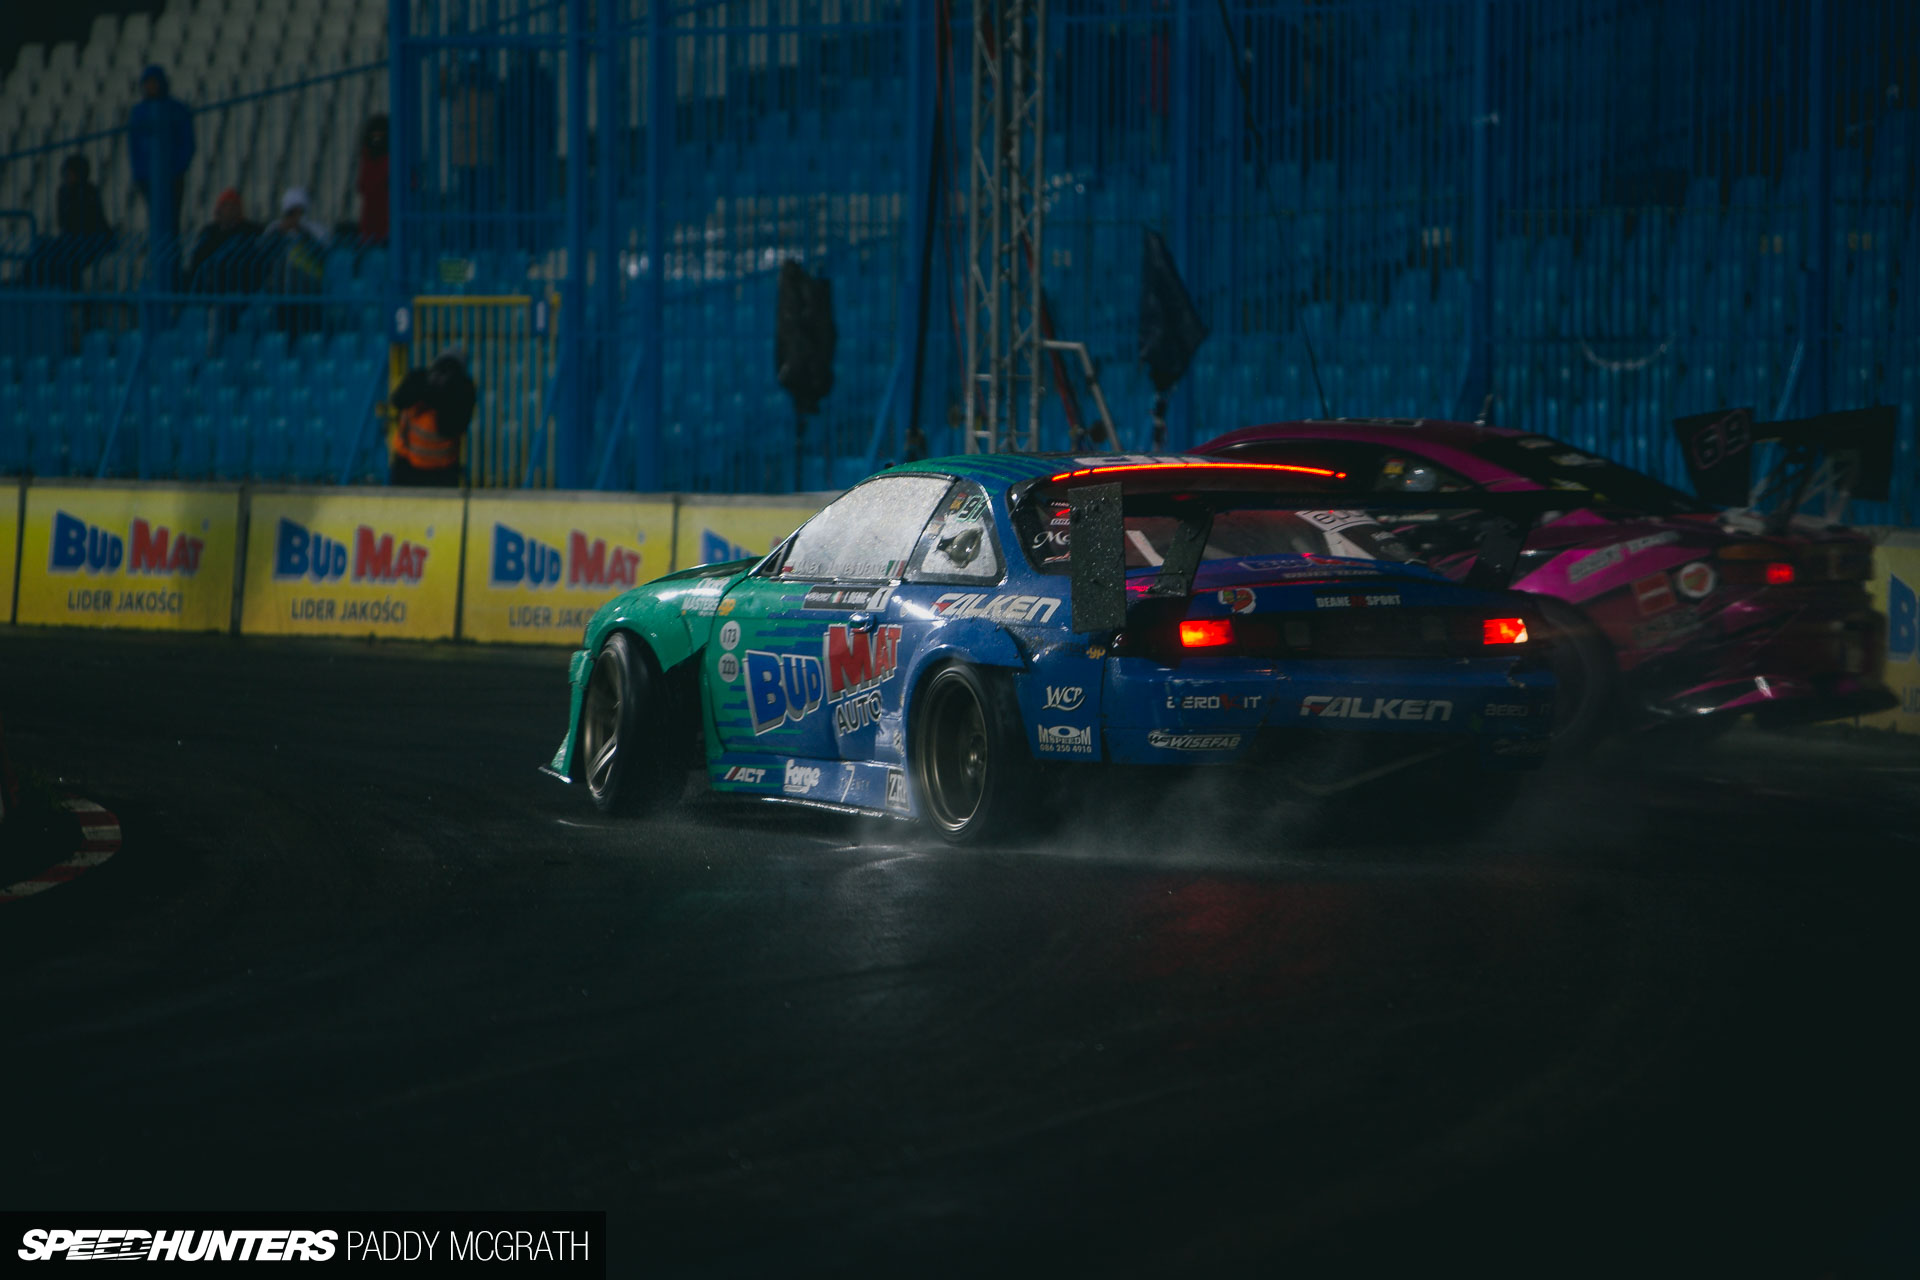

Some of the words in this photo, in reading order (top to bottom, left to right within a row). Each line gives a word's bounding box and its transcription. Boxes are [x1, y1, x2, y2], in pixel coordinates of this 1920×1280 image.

[51, 509, 123, 573] BUD
[128, 517, 205, 576] MAT
[275, 517, 348, 581] BUD
[353, 524, 429, 584] MAT
[491, 522, 561, 588] BUD
[567, 530, 640, 588] MAT
[68, 588, 111, 612] LIDER
[116, 587, 184, 615] JAKOŚCI
[292, 597, 335, 620] LIDER
[340, 595, 406, 623] JAKOŚCI
[931, 593, 1061, 623] FALKEN
[510, 604, 552, 628] LIDER
[723, 629, 737, 643] 173
[742, 649, 825, 736] BUD
[823, 624, 903, 705] MAT
[1043, 685, 1085, 710] WCP
[1298, 695, 1454, 721] FALKEN
[834, 689, 883, 737] AUTO
[1169, 735, 1241, 748] WISEFAB
[730, 766, 766, 784] ACT
